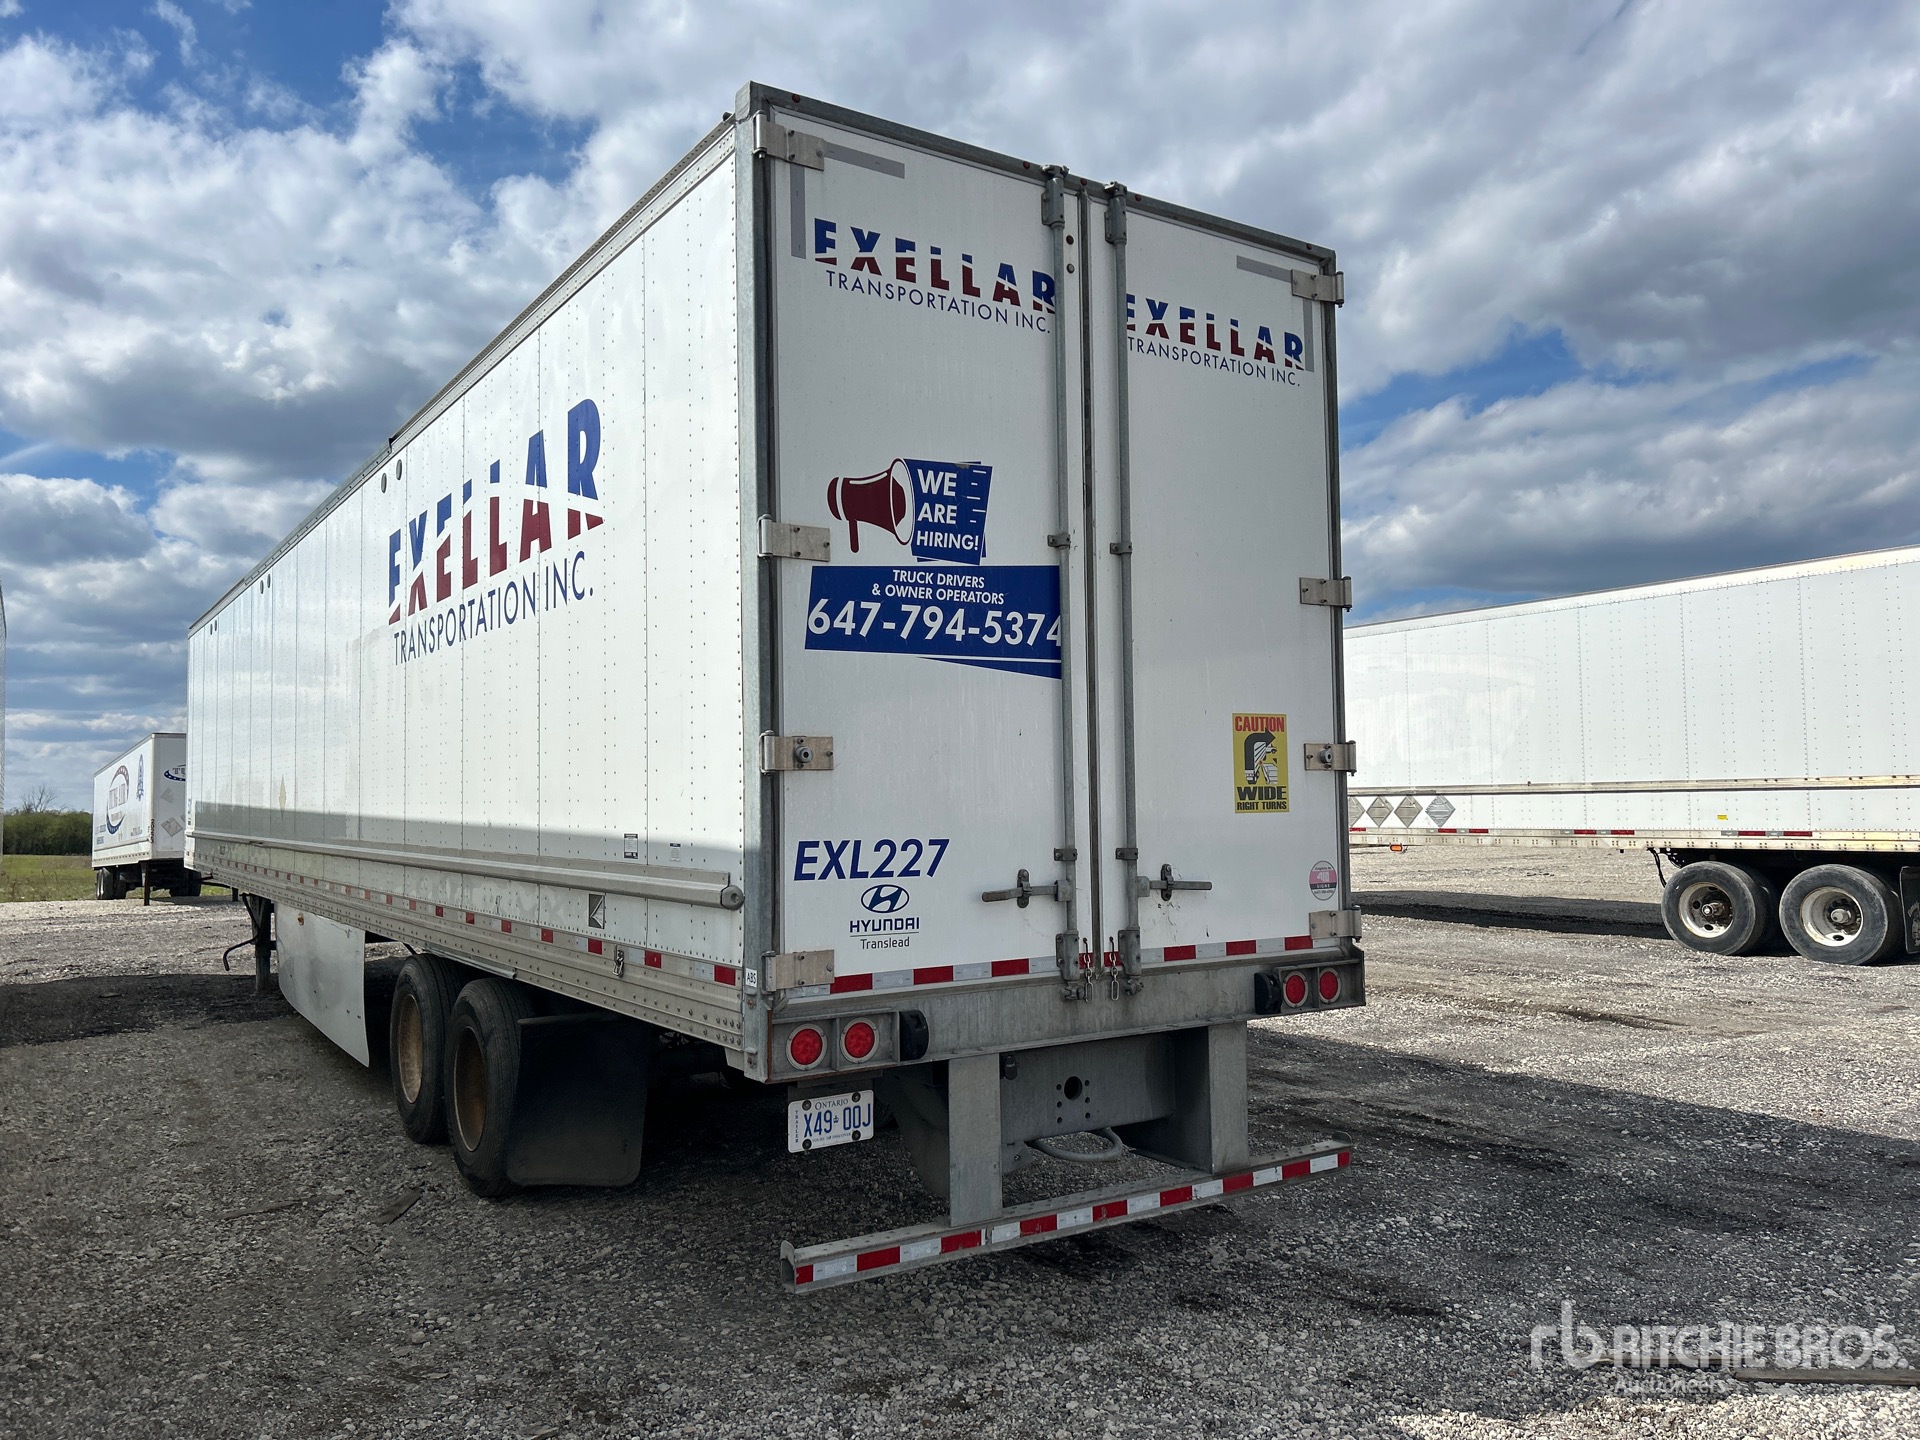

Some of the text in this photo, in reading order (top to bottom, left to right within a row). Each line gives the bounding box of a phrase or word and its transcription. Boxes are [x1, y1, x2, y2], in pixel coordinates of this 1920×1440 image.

[814, 217, 1056, 315] EXELLAR
[826, 269, 1050, 334] TRANSPORTATION INC.
[1127, 336, 1301, 387] TRANSPORTATION INC.
[917, 468, 957, 496] WE
[388, 398, 604, 625] EXELLAR
[917, 502, 957, 525] ARE
[916, 530, 979, 550] HIRING!
[892, 569, 985, 589] TRUCK DRIVERS
[871, 582, 1005, 606] & OWNER OPERATORS
[393, 550, 594, 666] TRANSPORTATION INC.
[807, 598, 1063, 648] 647-794-5374
[1234, 715, 1285, 733] CAUTION
[1237, 785, 1288, 801] WIDE
[1236, 801, 1288, 811] RIGHT TURNS
[794, 838, 950, 881] EXL227
[850, 917, 920, 933] HYUNDAI
[860, 936, 910, 950] Translead
[746, 971, 758, 985] ABS
[803, 1109, 833, 1138] X49
